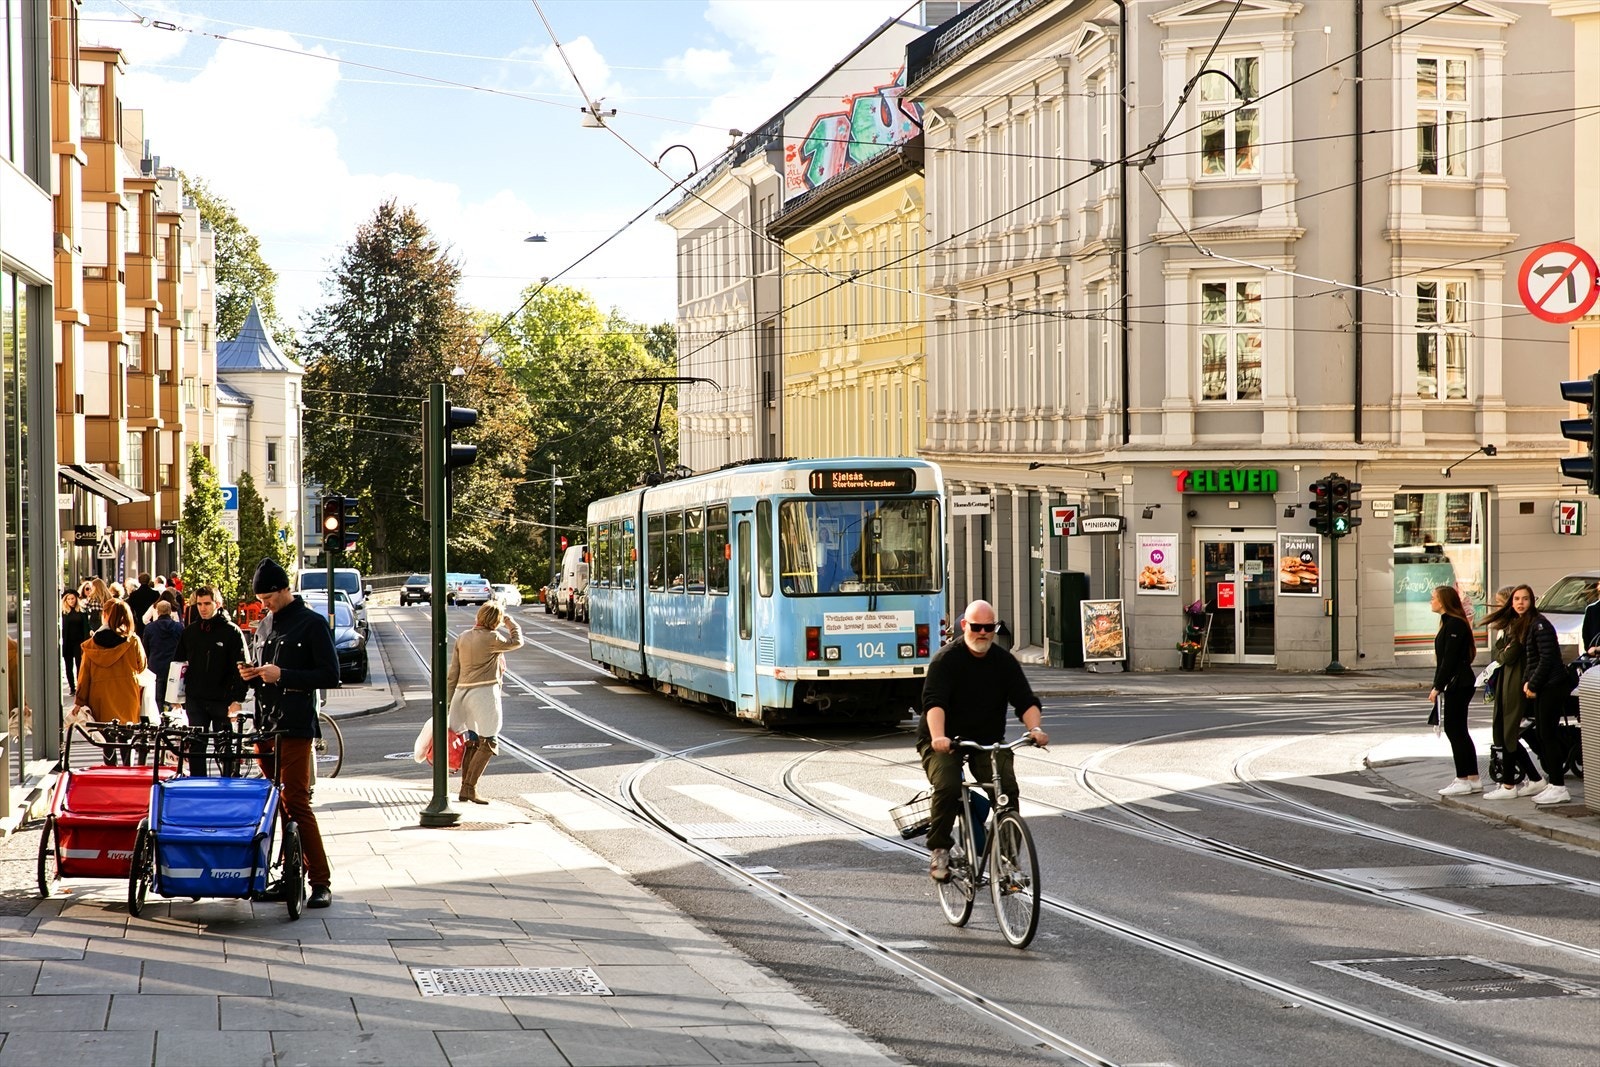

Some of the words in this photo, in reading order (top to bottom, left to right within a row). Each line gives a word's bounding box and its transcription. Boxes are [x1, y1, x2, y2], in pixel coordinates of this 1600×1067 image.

[811, 473, 823, 489] 11
[832, 472, 863, 480] Kjelsås
[856, 642, 885, 658] 104
